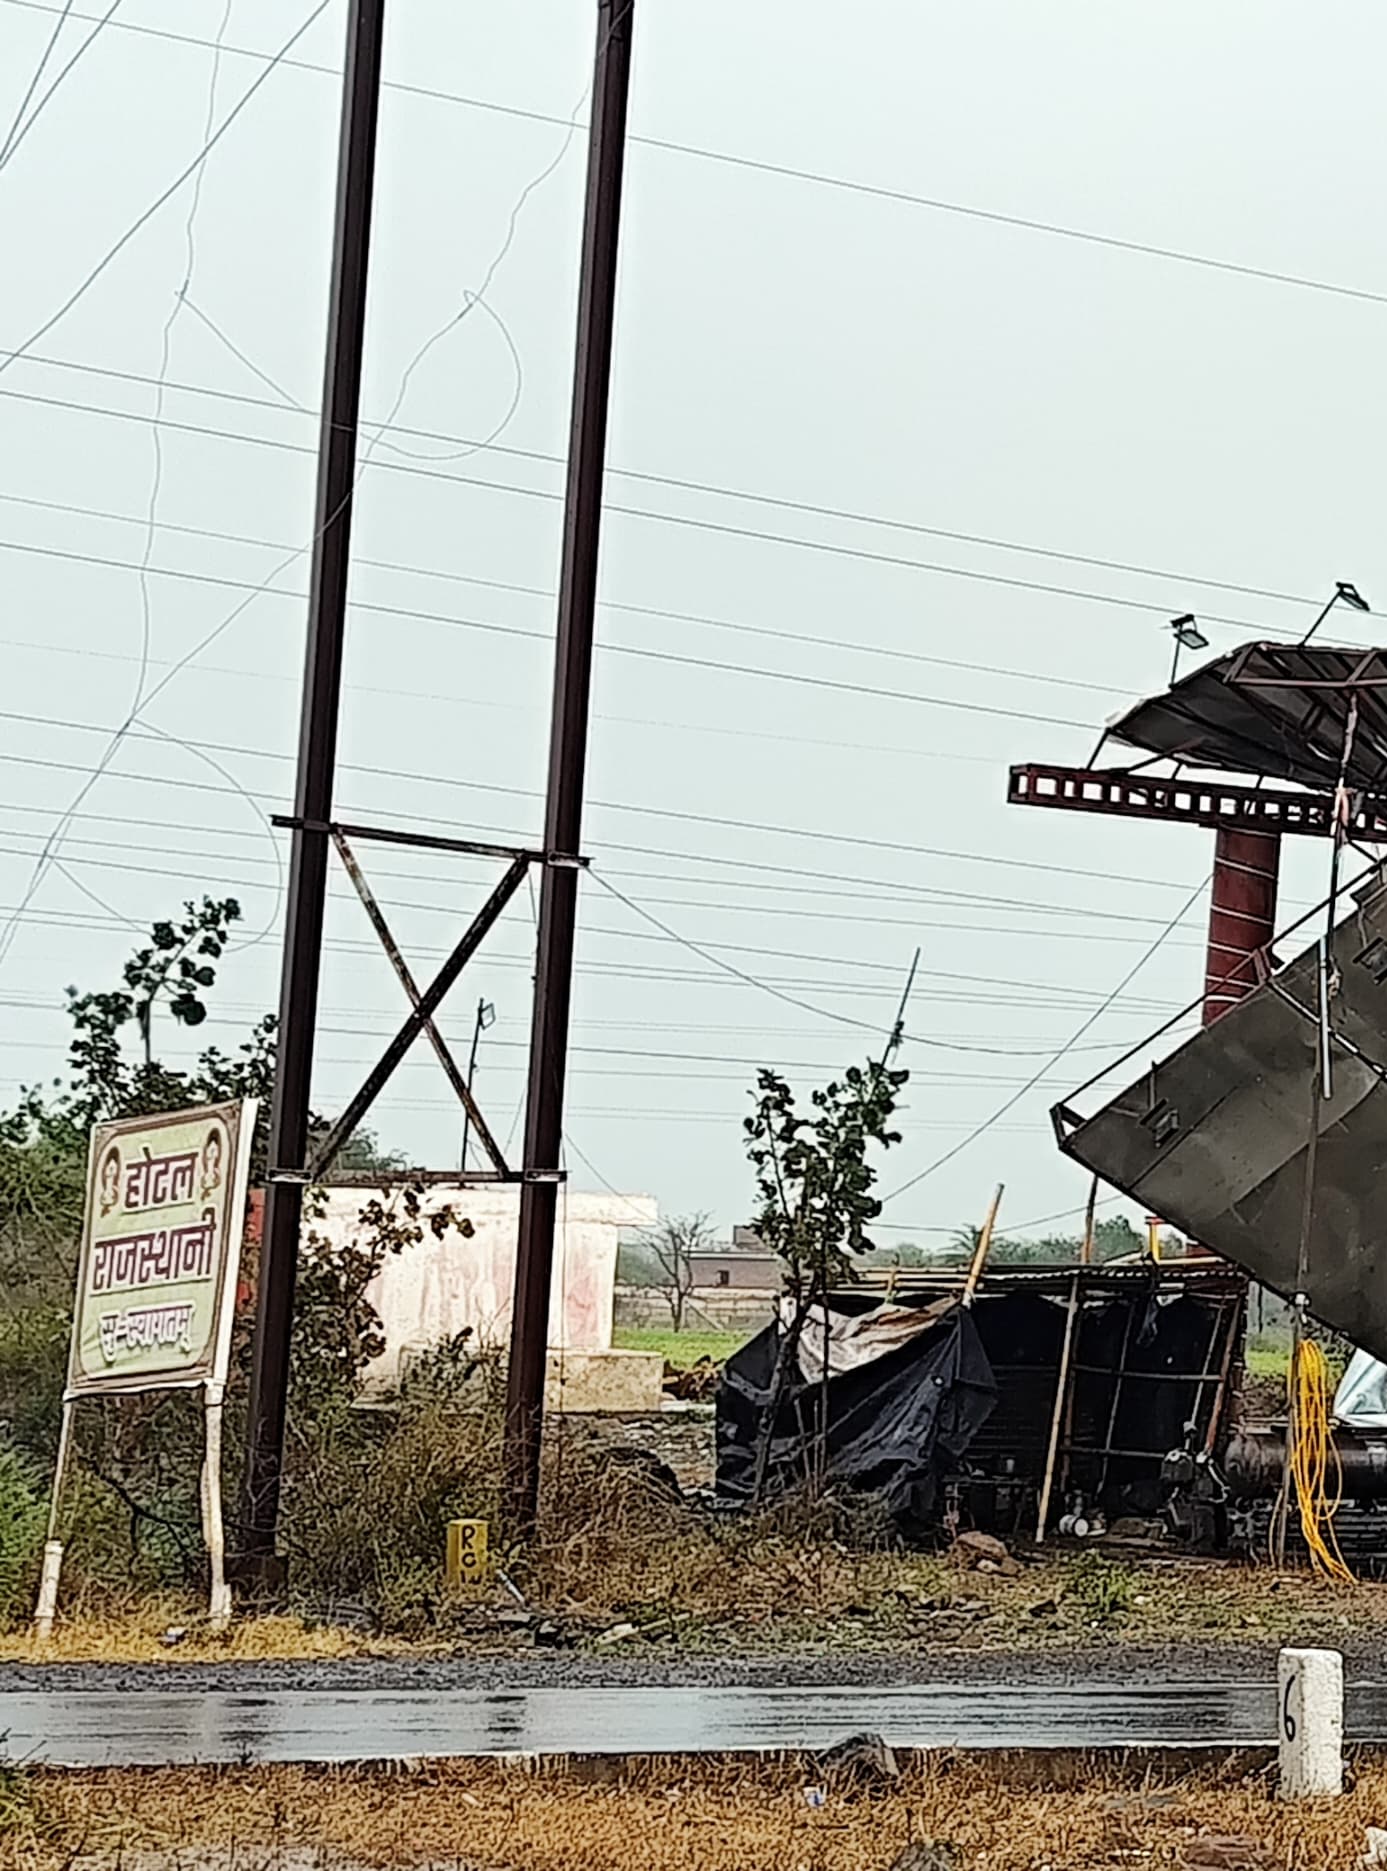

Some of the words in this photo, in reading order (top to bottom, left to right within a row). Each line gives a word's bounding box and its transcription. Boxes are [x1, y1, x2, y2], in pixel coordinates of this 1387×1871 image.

[124, 1146, 199, 1211] होटल
[92, 1207, 218, 1291] राजस्थानी
[1283, 1673, 1297, 1742] 6
